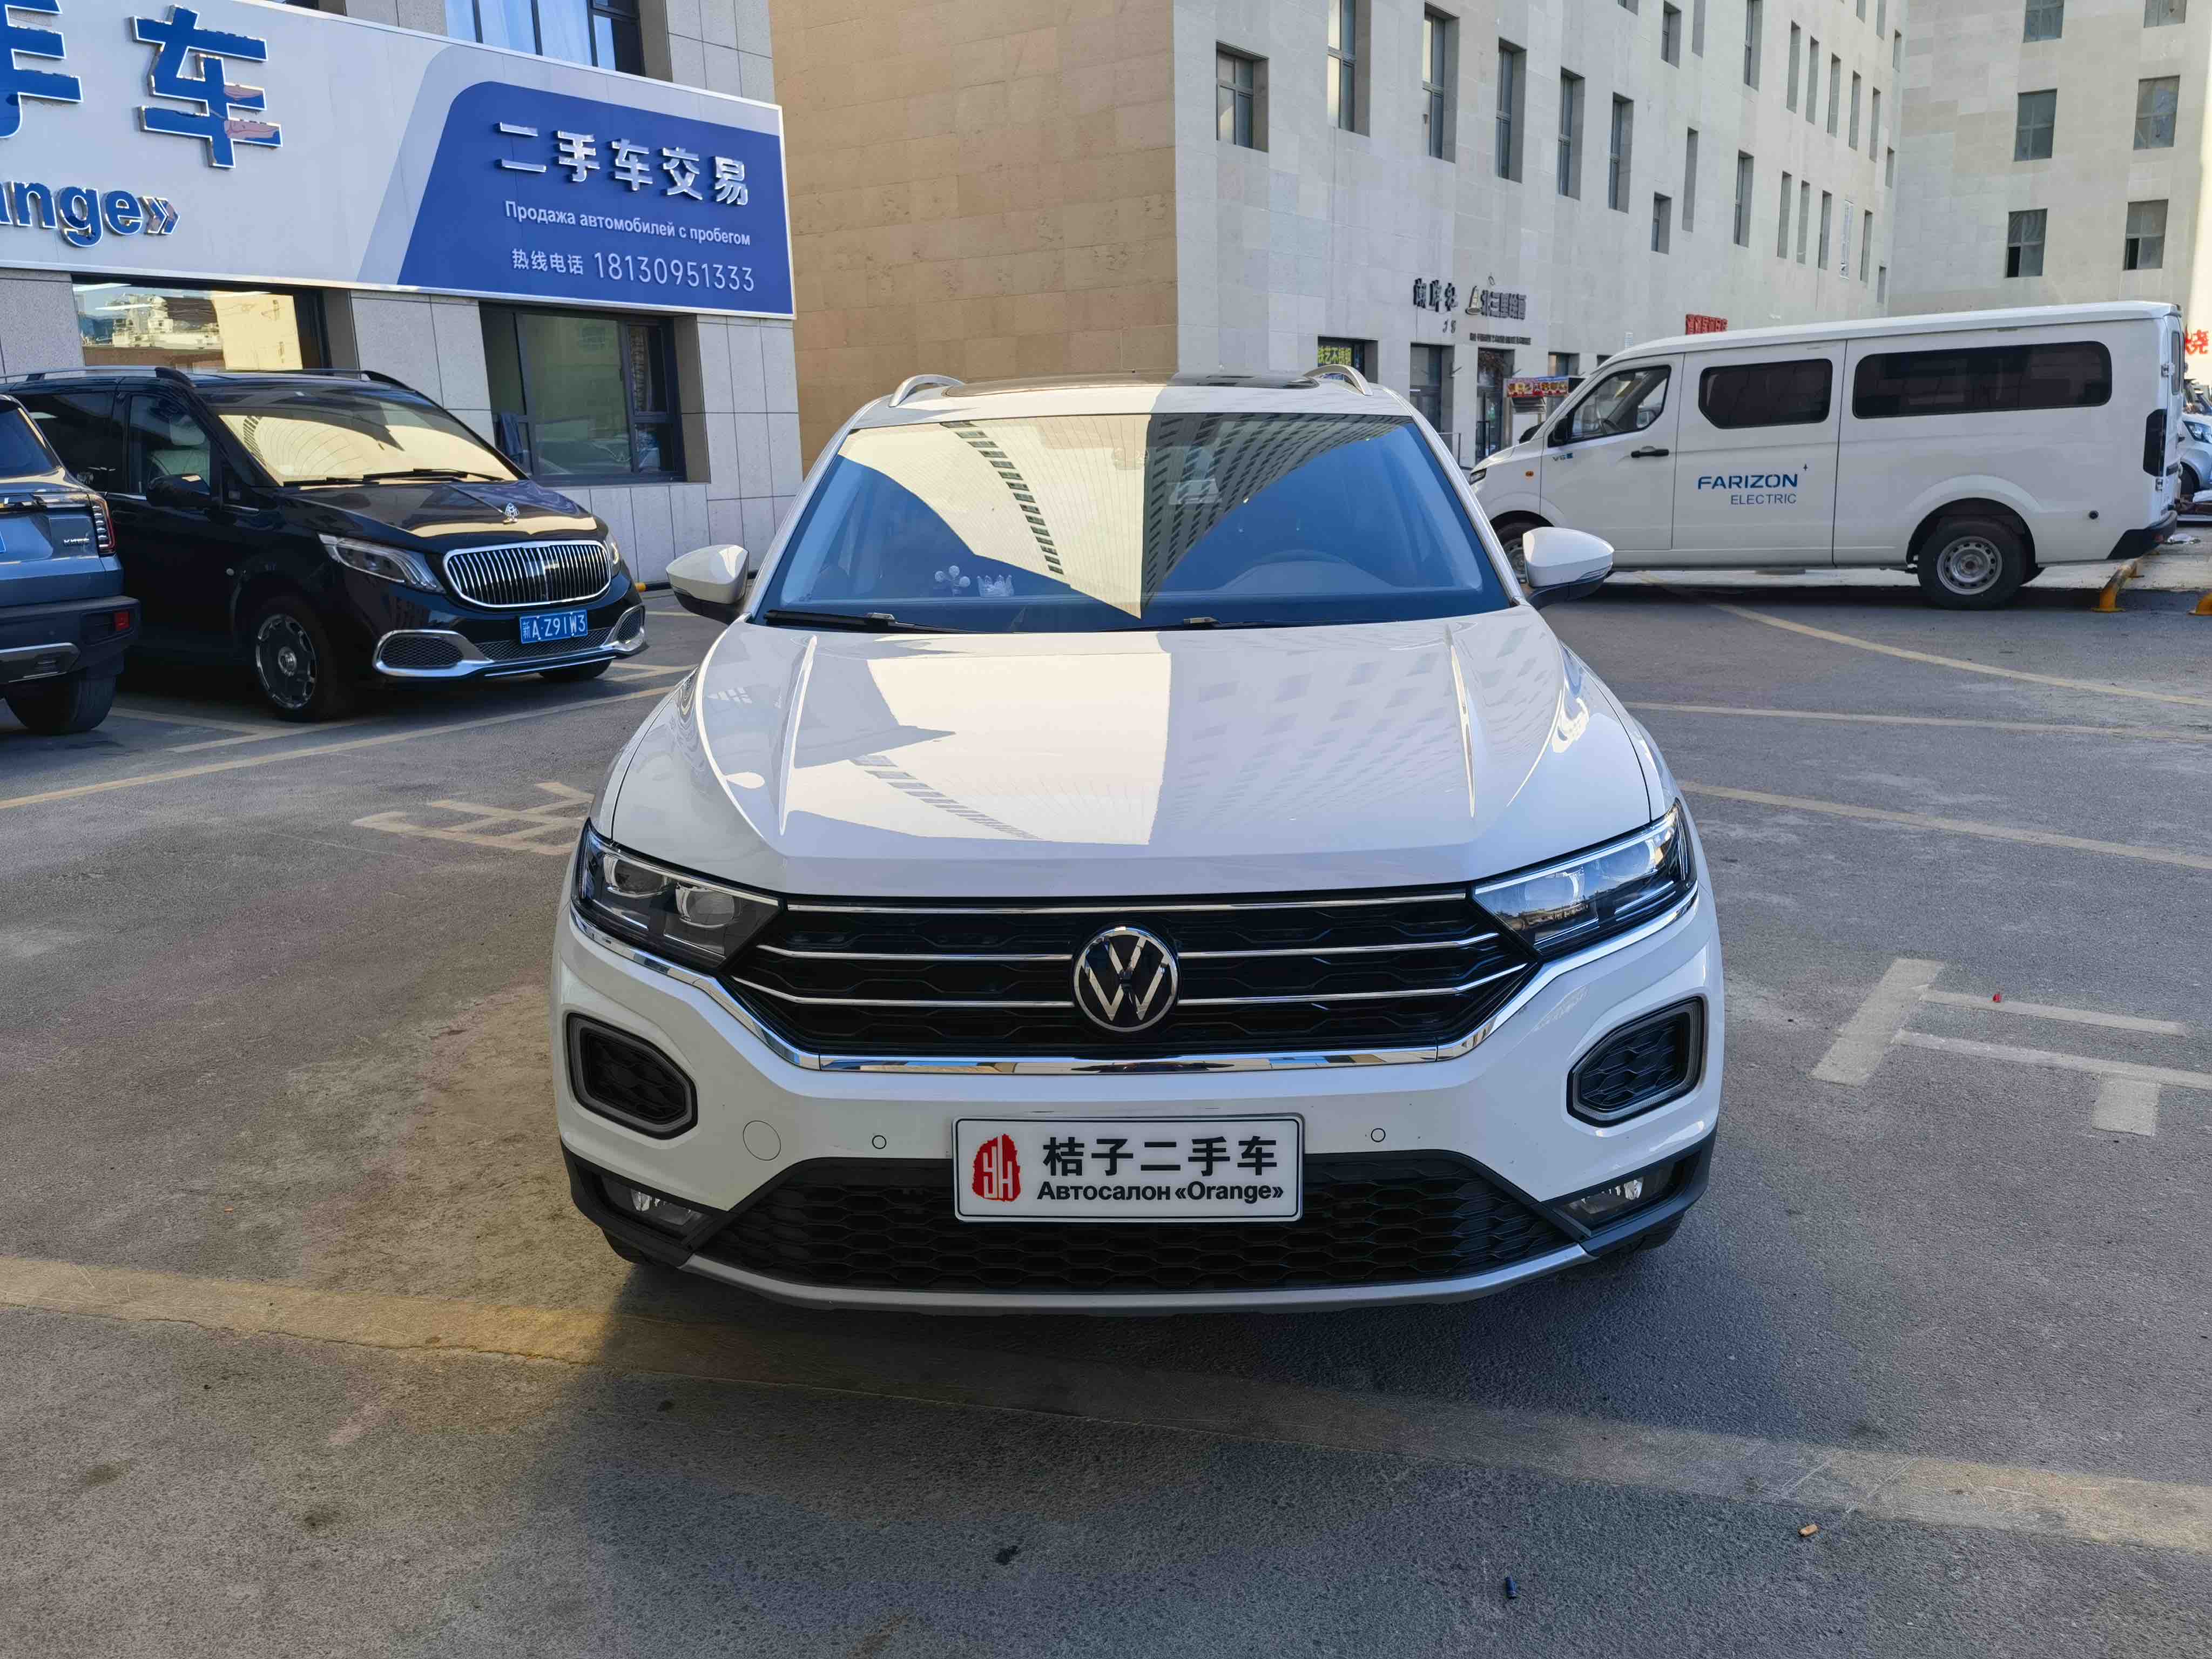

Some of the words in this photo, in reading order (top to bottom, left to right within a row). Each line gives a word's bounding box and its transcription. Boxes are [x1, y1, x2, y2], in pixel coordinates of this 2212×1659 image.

[496, 121, 749, 206] 二手车交易
[0, 181, 180, 247] nge»
[505, 200, 576, 226] Продажа
[579, 213, 676, 239] автомобилей
[679, 226, 687, 239] с
[690, 227, 751, 246] пробегом
[512, 248, 584, 275] 热线电话
[594, 252, 754, 292] 18130951333
[1697, 474, 1798, 489] FARIZON
[1730, 493, 1797, 505] ELECTRIC
[1042, 1136, 1278, 1176] 桔子二手车
